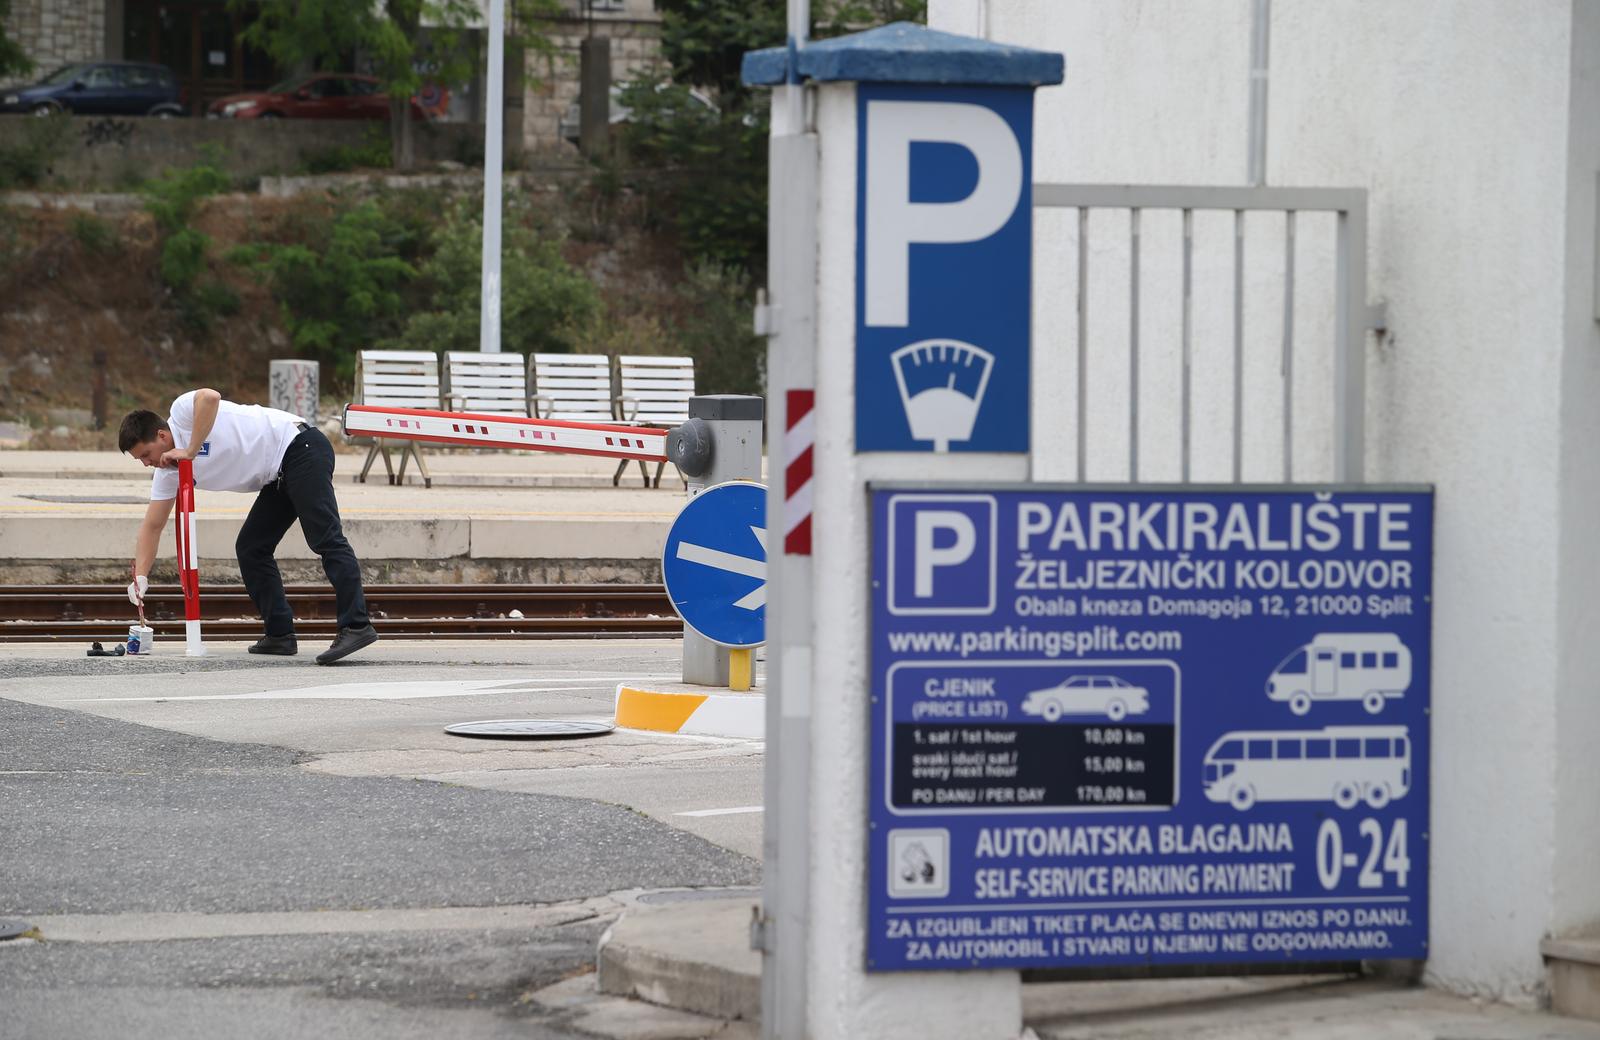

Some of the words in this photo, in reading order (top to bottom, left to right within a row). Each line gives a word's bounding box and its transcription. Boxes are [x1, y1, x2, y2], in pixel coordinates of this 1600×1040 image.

[864, 100, 1023, 327] P
[1017, 492, 1412, 551] PARKIRALIŠTE
[914, 511, 976, 598] P
[1014, 553, 1226, 590] ŽELJEZNIČKI
[1235, 559, 1413, 589] KOLODVOR
[1014, 596, 1077, 617] Obala
[1081, 596, 1143, 617] kneza
[1147, 595, 1253, 619] Domagoja
[1260, 595, 1290, 617] 12,
[1295, 594, 1363, 615] 21000
[1366, 594, 1412, 618] Split
[888, 626, 1182, 658] www.parkingsplit.com
[924, 677, 995, 698] CJENIK
[912, 702, 964, 719] (PRICE
[968, 701, 1008, 719] LIST)
[928, 729, 950, 744] sat
[984, 728, 1016, 742] hour
[1125, 727, 1145, 744] kn
[985, 762, 1017, 777] hour
[1125, 755, 1145, 771] kn
[912, 786, 934, 803] PO
[936, 785, 976, 801] DANU
[985, 784, 1015, 800] PER
[1017, 784, 1046, 800] DAY
[1126, 785, 1146, 803] kn
[975, 826, 1153, 857] AUTOMATSKA
[1158, 823, 1293, 854] BLAGAJNA
[1316, 817, 1411, 890] 0-24
[974, 867, 1109, 899] SELF-SERVICE
[1112, 865, 1200, 896] PARKING
[1202, 863, 1295, 893] PAYMENT
[886, 918, 913, 939] ZA
[916, 916, 1029, 937] IZGUBLJENI
[1033, 914, 1087, 934] TIKET
[1091, 912, 1156, 933] PLAĆA
[1159, 911, 1183, 932] SE
[1188, 909, 1258, 930] DNEVNI
[1262, 908, 1319, 929] IZNOS
[1323, 907, 1350, 927] PO
[1354, 907, 1411, 927] DANU.
[905, 941, 933, 961] ZA
[934, 937, 1049, 960] AUTOMOBIL
[1052, 937, 1060, 956] I
[1063, 935, 1131, 956] STVARI
[1134, 933, 1149, 953] U
[1152, 933, 1218, 954] NJEMU
[1221, 931, 1247, 952] NE
[1251, 930, 1392, 950] ODGOVARAMO.
